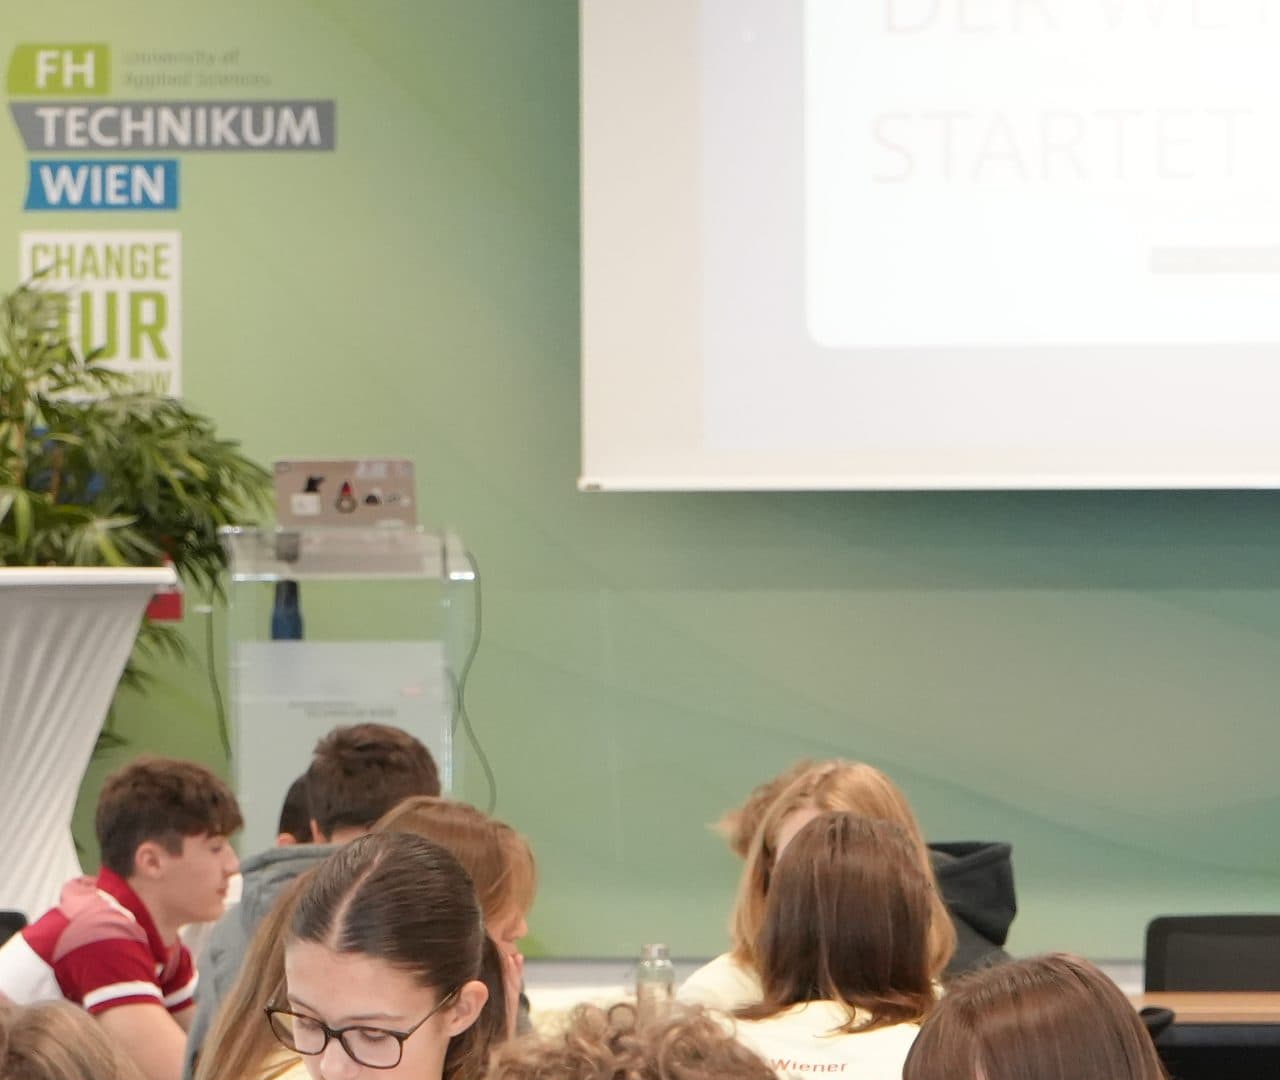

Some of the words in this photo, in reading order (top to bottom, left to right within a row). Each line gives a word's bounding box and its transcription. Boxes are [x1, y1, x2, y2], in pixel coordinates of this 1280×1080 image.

[35, 50, 95, 88] FH
[37, 107, 321, 147] TECHNIKUM
[870, 108, 1255, 184] STARTET
[39, 165, 165, 204] WIEN
[31, 244, 171, 280] CHANGE
[771, 1058, 848, 1073] Wiener
